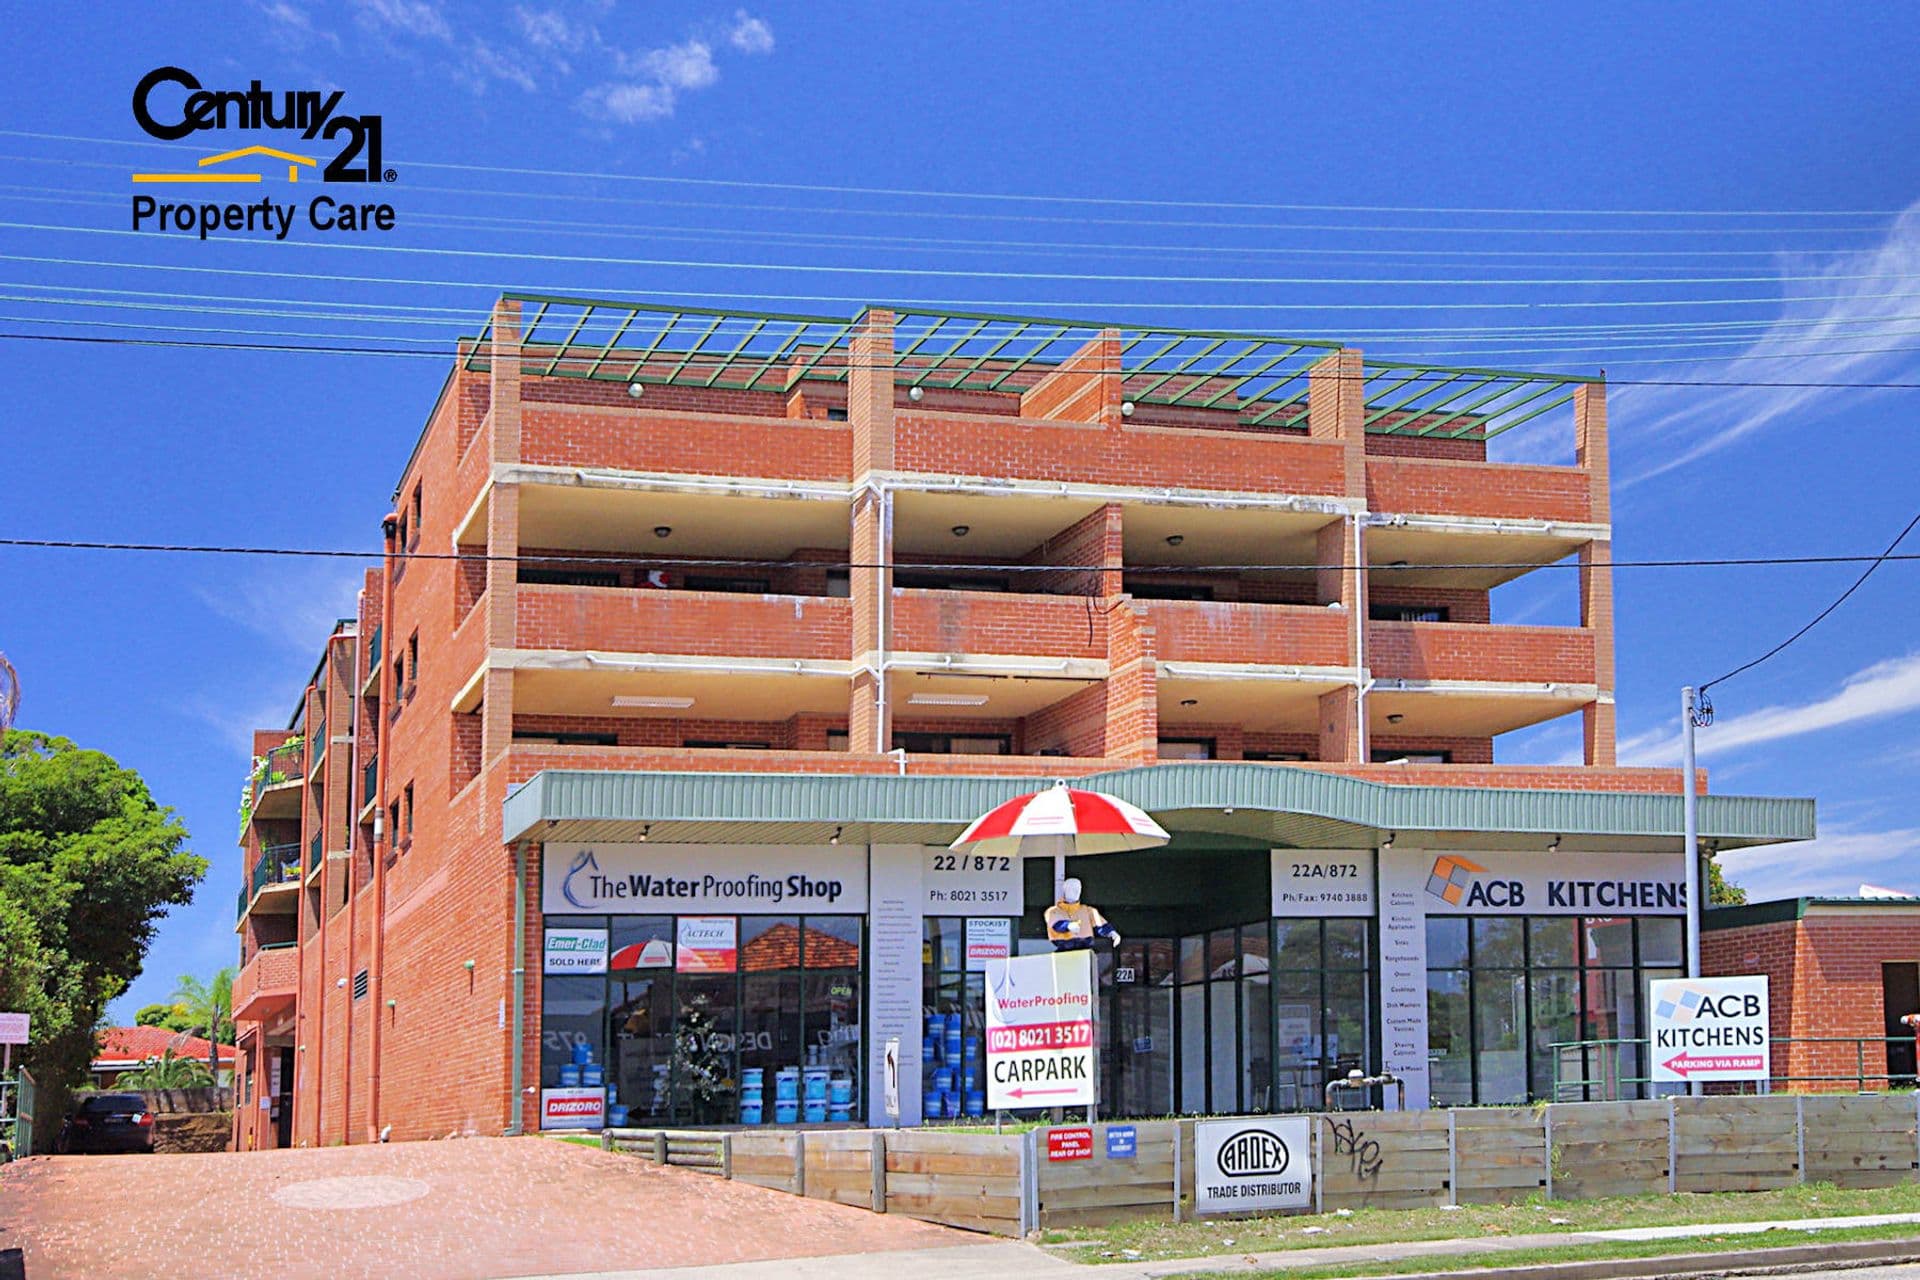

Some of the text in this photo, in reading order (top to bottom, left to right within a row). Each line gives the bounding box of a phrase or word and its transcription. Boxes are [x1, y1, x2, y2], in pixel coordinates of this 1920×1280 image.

[934, 856, 956, 871] 22
[974, 856, 1010, 871] 872
[1292, 864, 1357, 879] 22A/872
[787, 876, 842, 902] Shop
[930, 890, 1008, 901] Ph: 8021 3517
[1320, 893, 1343, 902] 9740
[1346, 893, 1367, 902] 3888
[1467, 881, 1525, 907] ACB
[549, 958, 575, 966] SOLD
[1695, 994, 1761, 1019] ACB
[991, 1024, 1090, 1051] (02) 8021 3517
[1657, 1026, 1764, 1048] KITCHENS
[994, 1055, 1087, 1083] CARPARK
[1671, 1059, 1760, 1069] PARKING VIA RAMP
[549, 1101, 601, 1112] DRIZORO
[1223, 1136, 1282, 1170] ARDEX
[1207, 1182, 1301, 1199] TRADE DISTRIBUTOR
